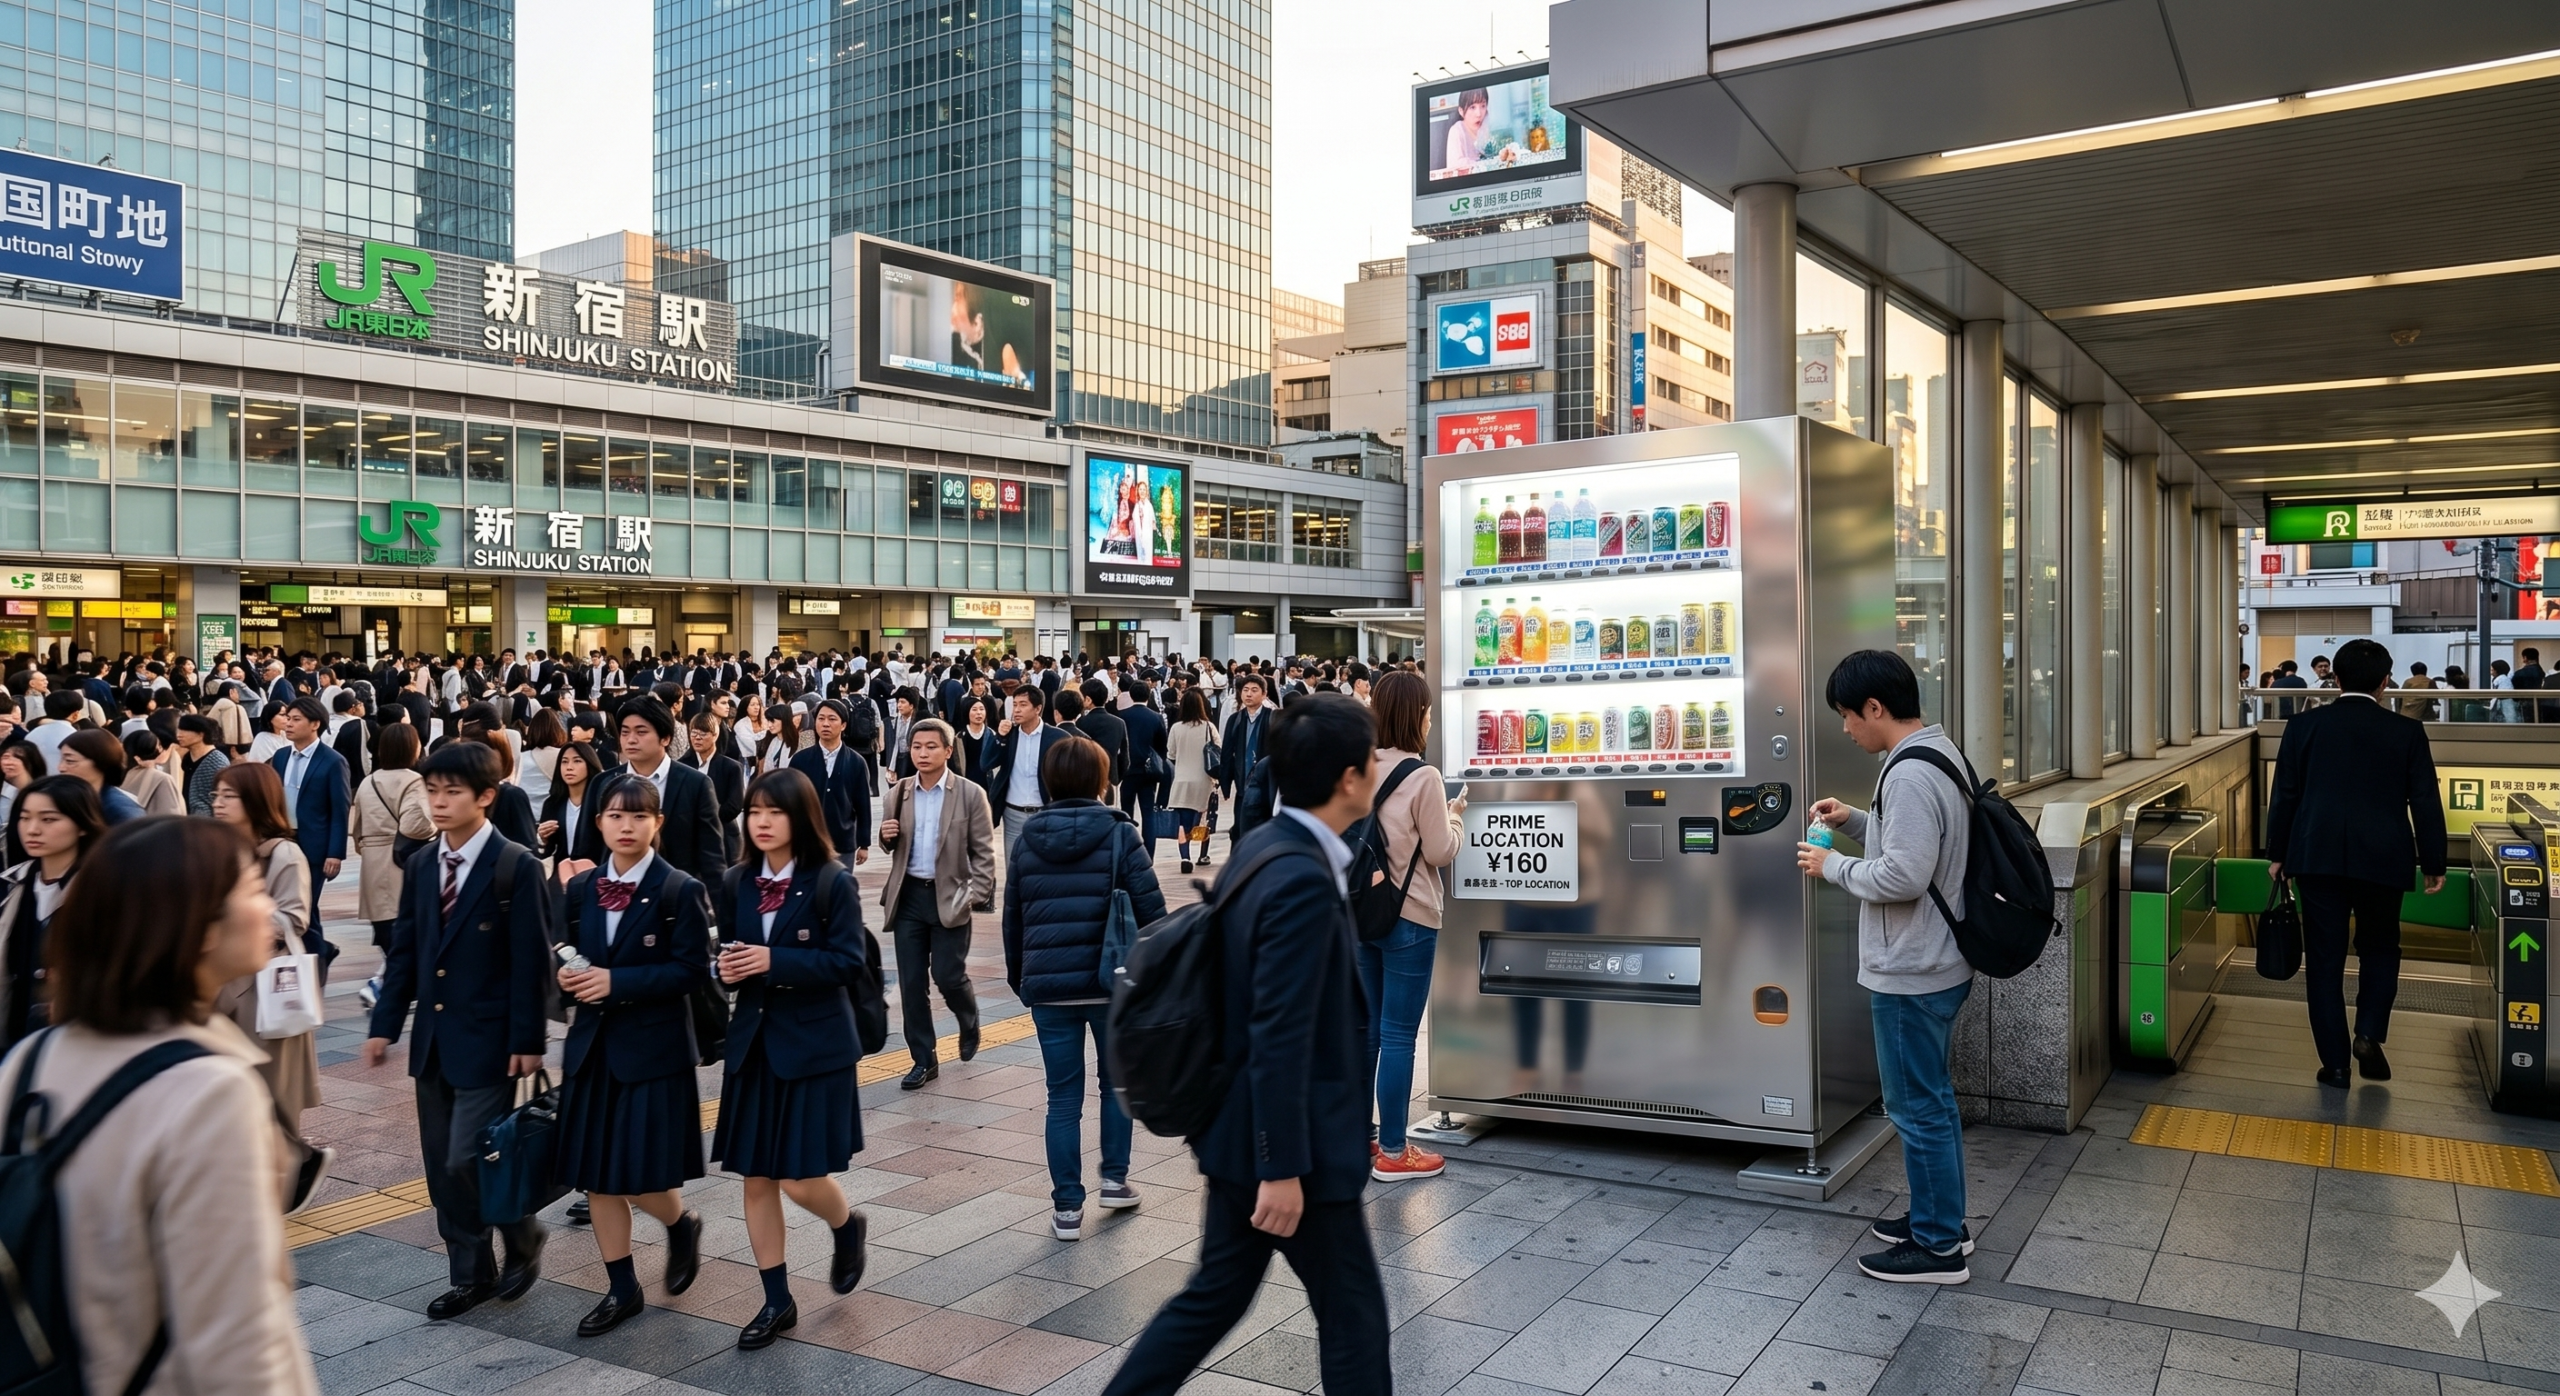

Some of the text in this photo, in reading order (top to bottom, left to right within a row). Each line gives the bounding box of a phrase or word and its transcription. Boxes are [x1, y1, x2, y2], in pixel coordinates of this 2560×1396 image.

[1450, 197, 1470, 212] JR
[81, 245, 144, 276] Stowy
[319, 240, 437, 317] JR
[483, 263, 708, 351] 新宿駅
[326, 308, 431, 340] JR東日本
[483, 326, 733, 384] SHINJUKU STATION
[360, 500, 442, 547] JR
[474, 504, 652, 553] 新宿駅
[474, 549, 652, 574] SHINJUKU STATION
[1487, 815, 1545, 829] PRIME
[1471, 832, 1564, 848] LOCATION
[1486, 852, 1547, 874] ¥160
[1505, 880, 1523, 889] TOP
[1525, 880, 1570, 890] LOCATION
